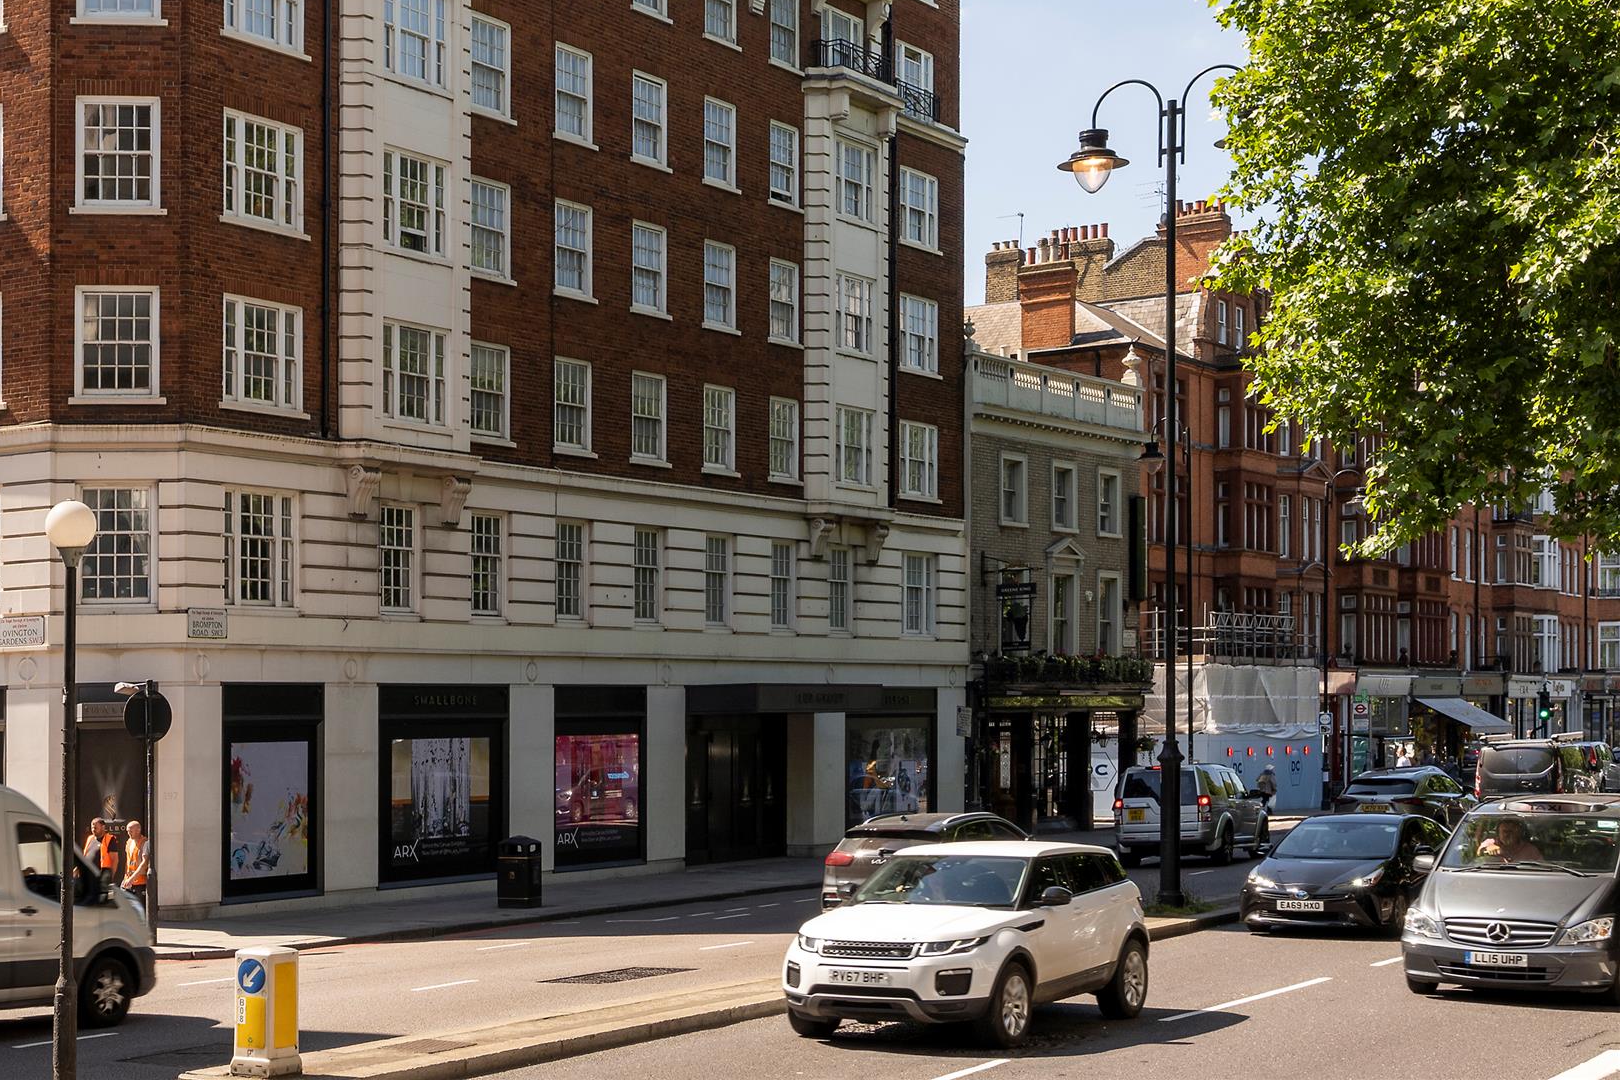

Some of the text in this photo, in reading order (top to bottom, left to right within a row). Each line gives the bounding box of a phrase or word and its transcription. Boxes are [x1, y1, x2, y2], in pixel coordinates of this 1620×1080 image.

[192, 621, 223, 629] BROMPTON
[2, 629, 37, 638] OVINGTON
[557, 827, 579, 848] ARX
[393, 839, 419, 862] ARX
[1280, 901, 1302, 909] EA69
[1474, 953, 1523, 965] LL15 UHP
[863, 972, 885, 983] BHF
